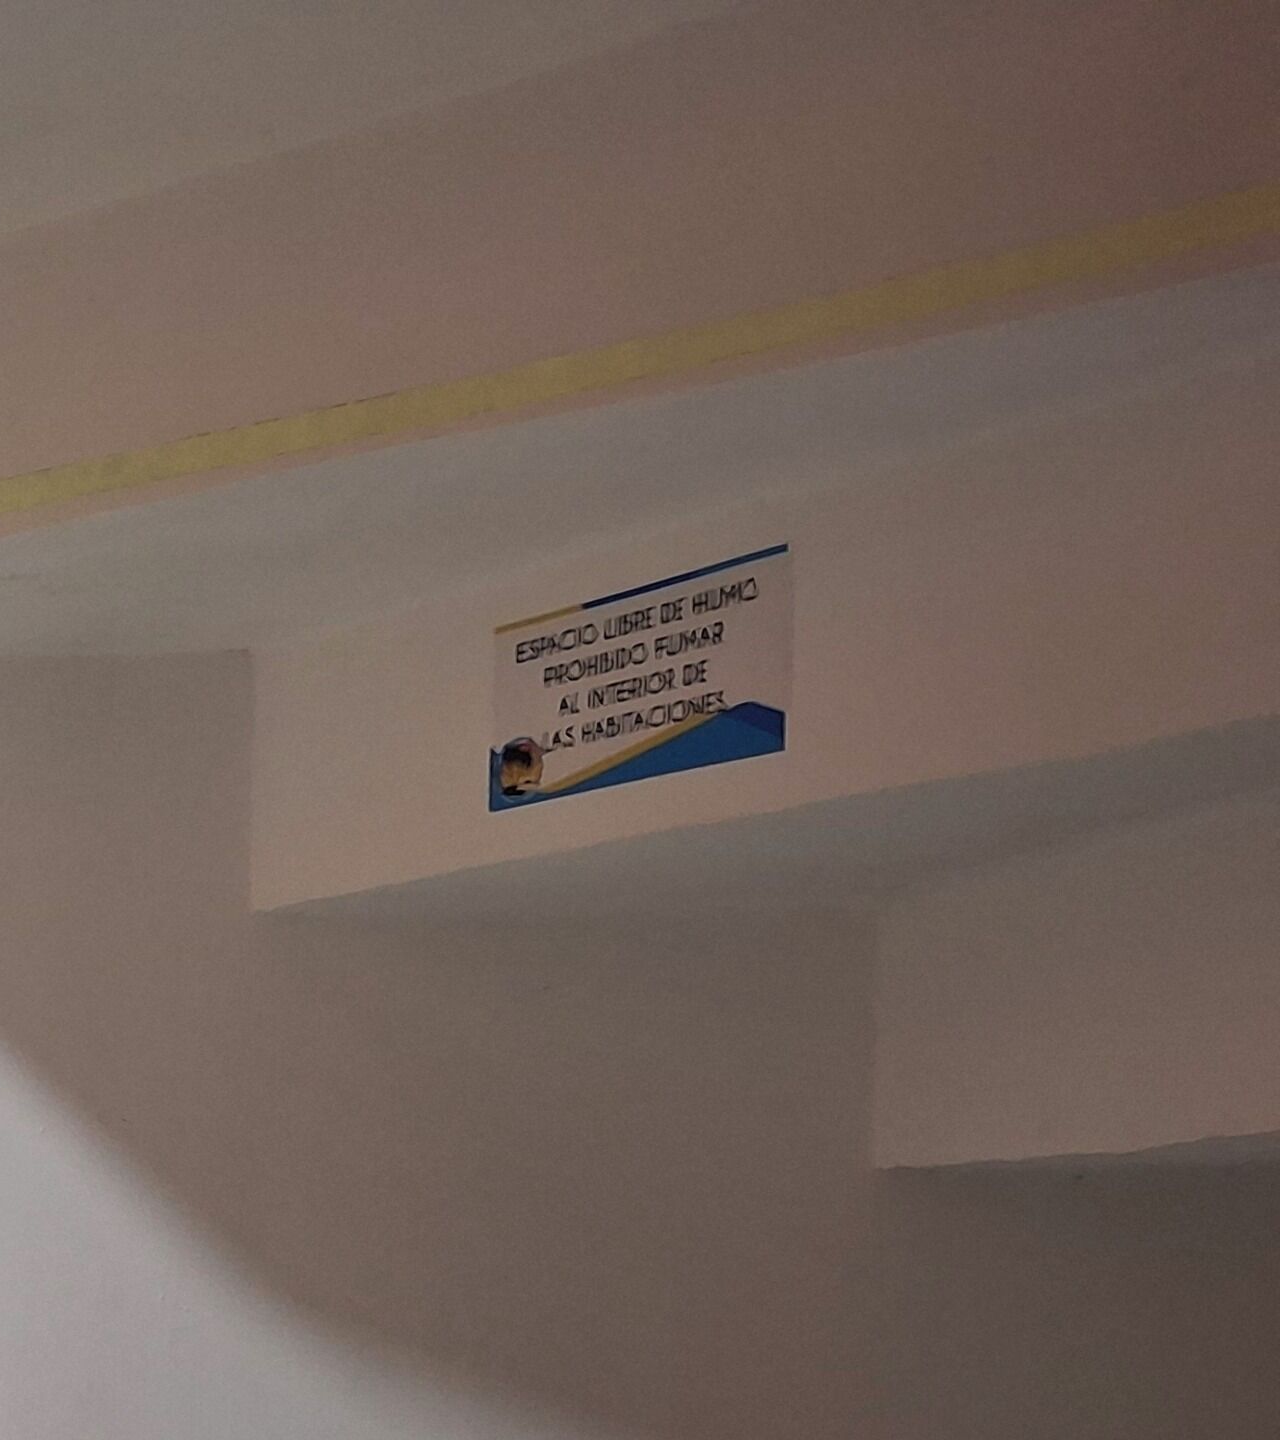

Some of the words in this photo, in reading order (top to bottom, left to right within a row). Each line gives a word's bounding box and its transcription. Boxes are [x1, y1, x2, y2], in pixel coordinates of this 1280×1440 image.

[516, 624, 599, 664] ESPACIO
[603, 606, 657, 641] LIBRE
[660, 596, 687, 625] DE
[692, 577, 760, 615] HUMO
[543, 642, 649, 687] PROHIBIDO
[654, 621, 725, 660] FUMAR
[559, 691, 580, 717] AL
[588, 668, 677, 710] INTERIOR
[683, 659, 708, 687] DE
[542, 726, 575, 752] LAS
[581, 690, 728, 743] HABITACIONES
